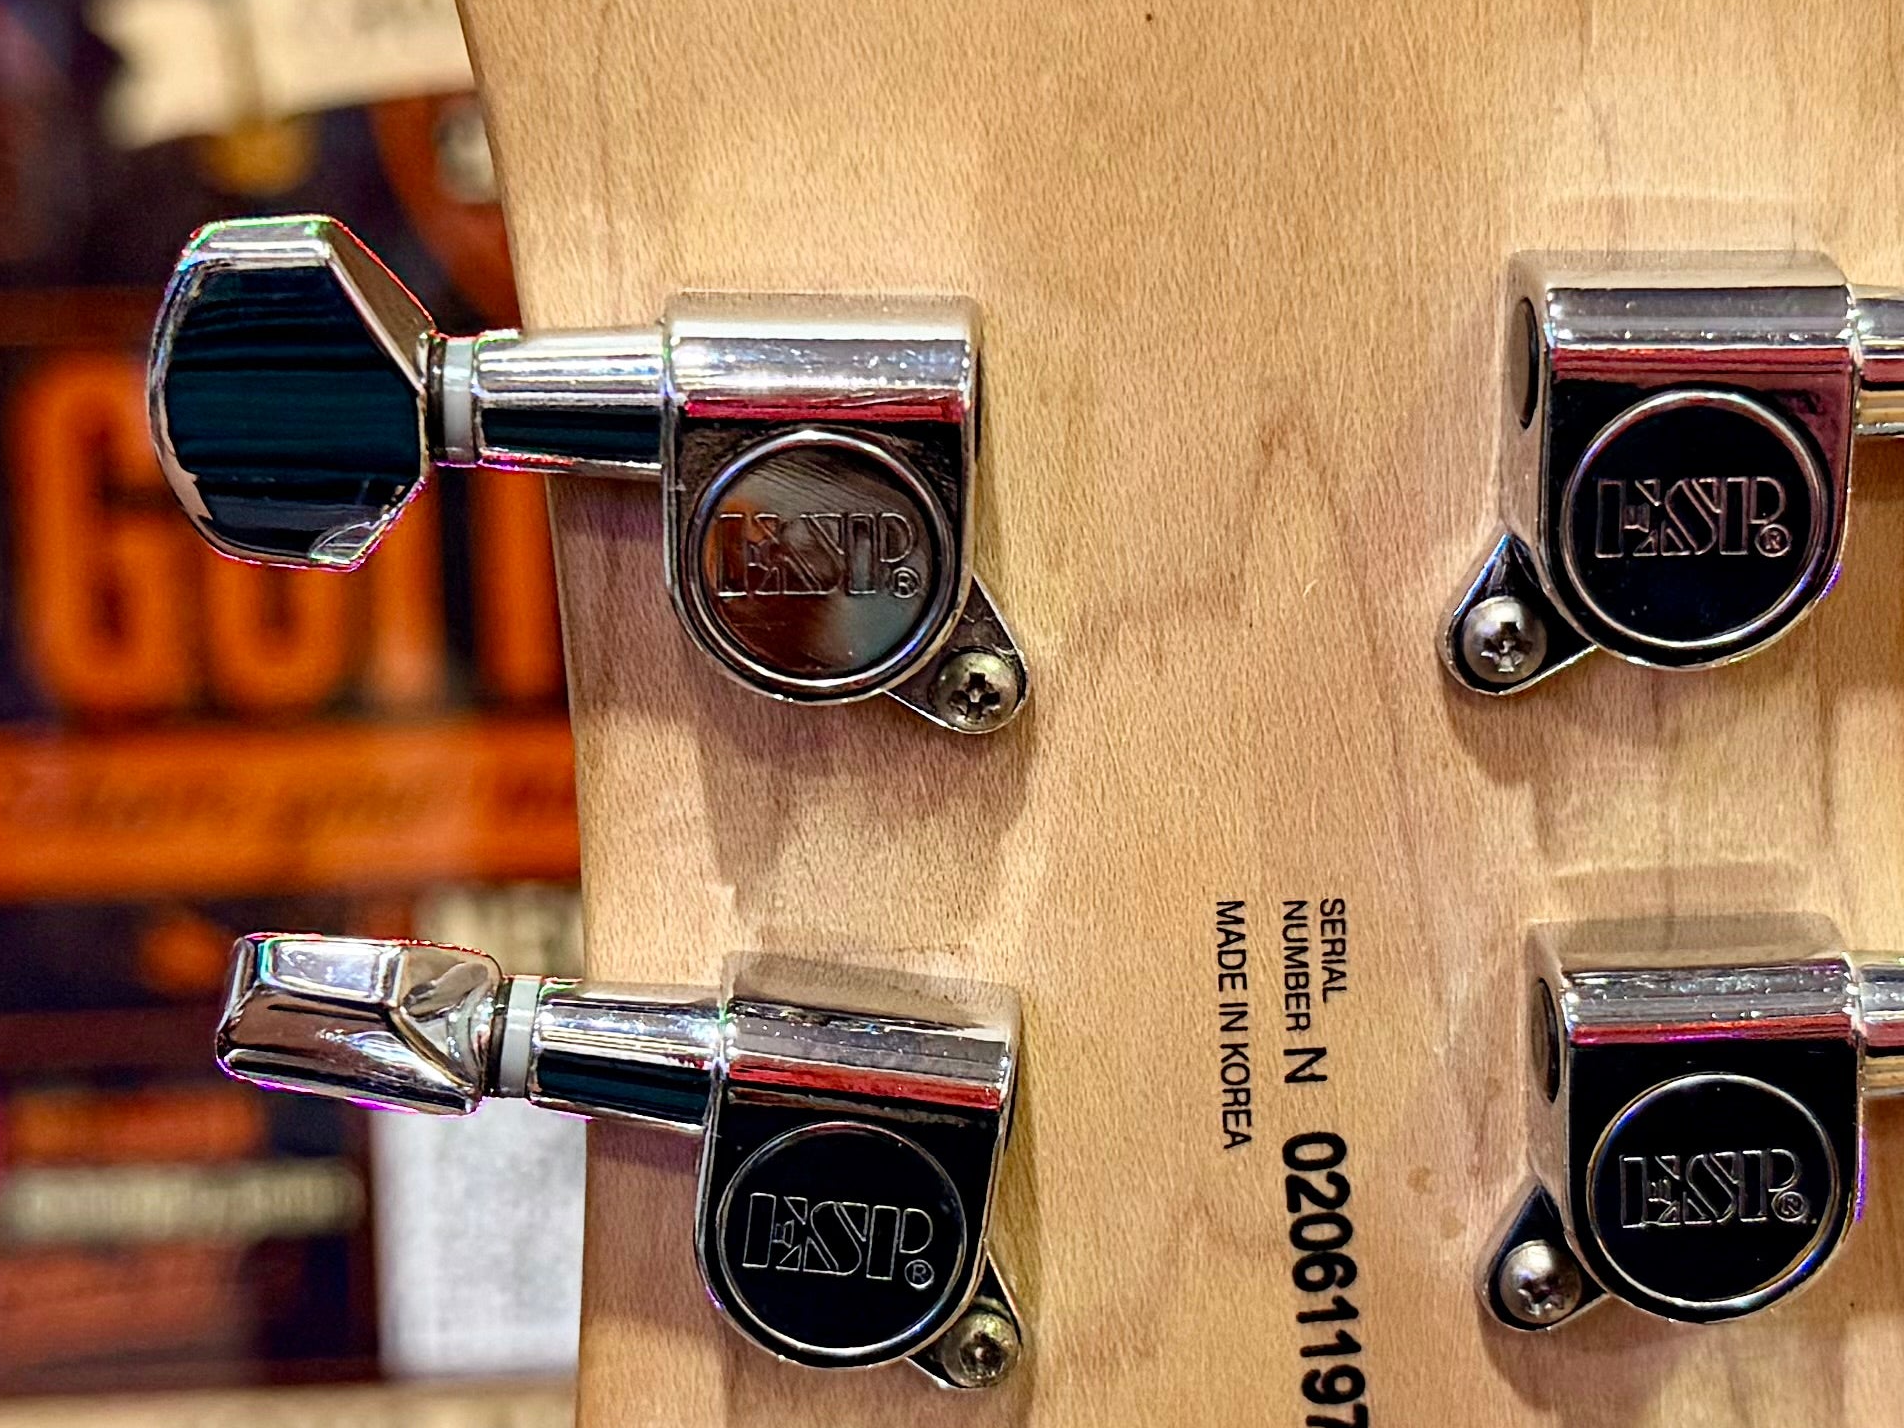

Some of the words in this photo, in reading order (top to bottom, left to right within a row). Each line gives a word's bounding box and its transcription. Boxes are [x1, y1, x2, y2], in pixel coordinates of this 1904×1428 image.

[1216, 900, 1248, 993] MADE
[1282, 900, 1312, 1032] NUMBER
[1319, 898, 1348, 1004] SERIAL
[1218, 1002, 1249, 1032] IN
[1283, 1047, 1328, 1084] N
[1220, 1043, 1252, 1150] KOREA
